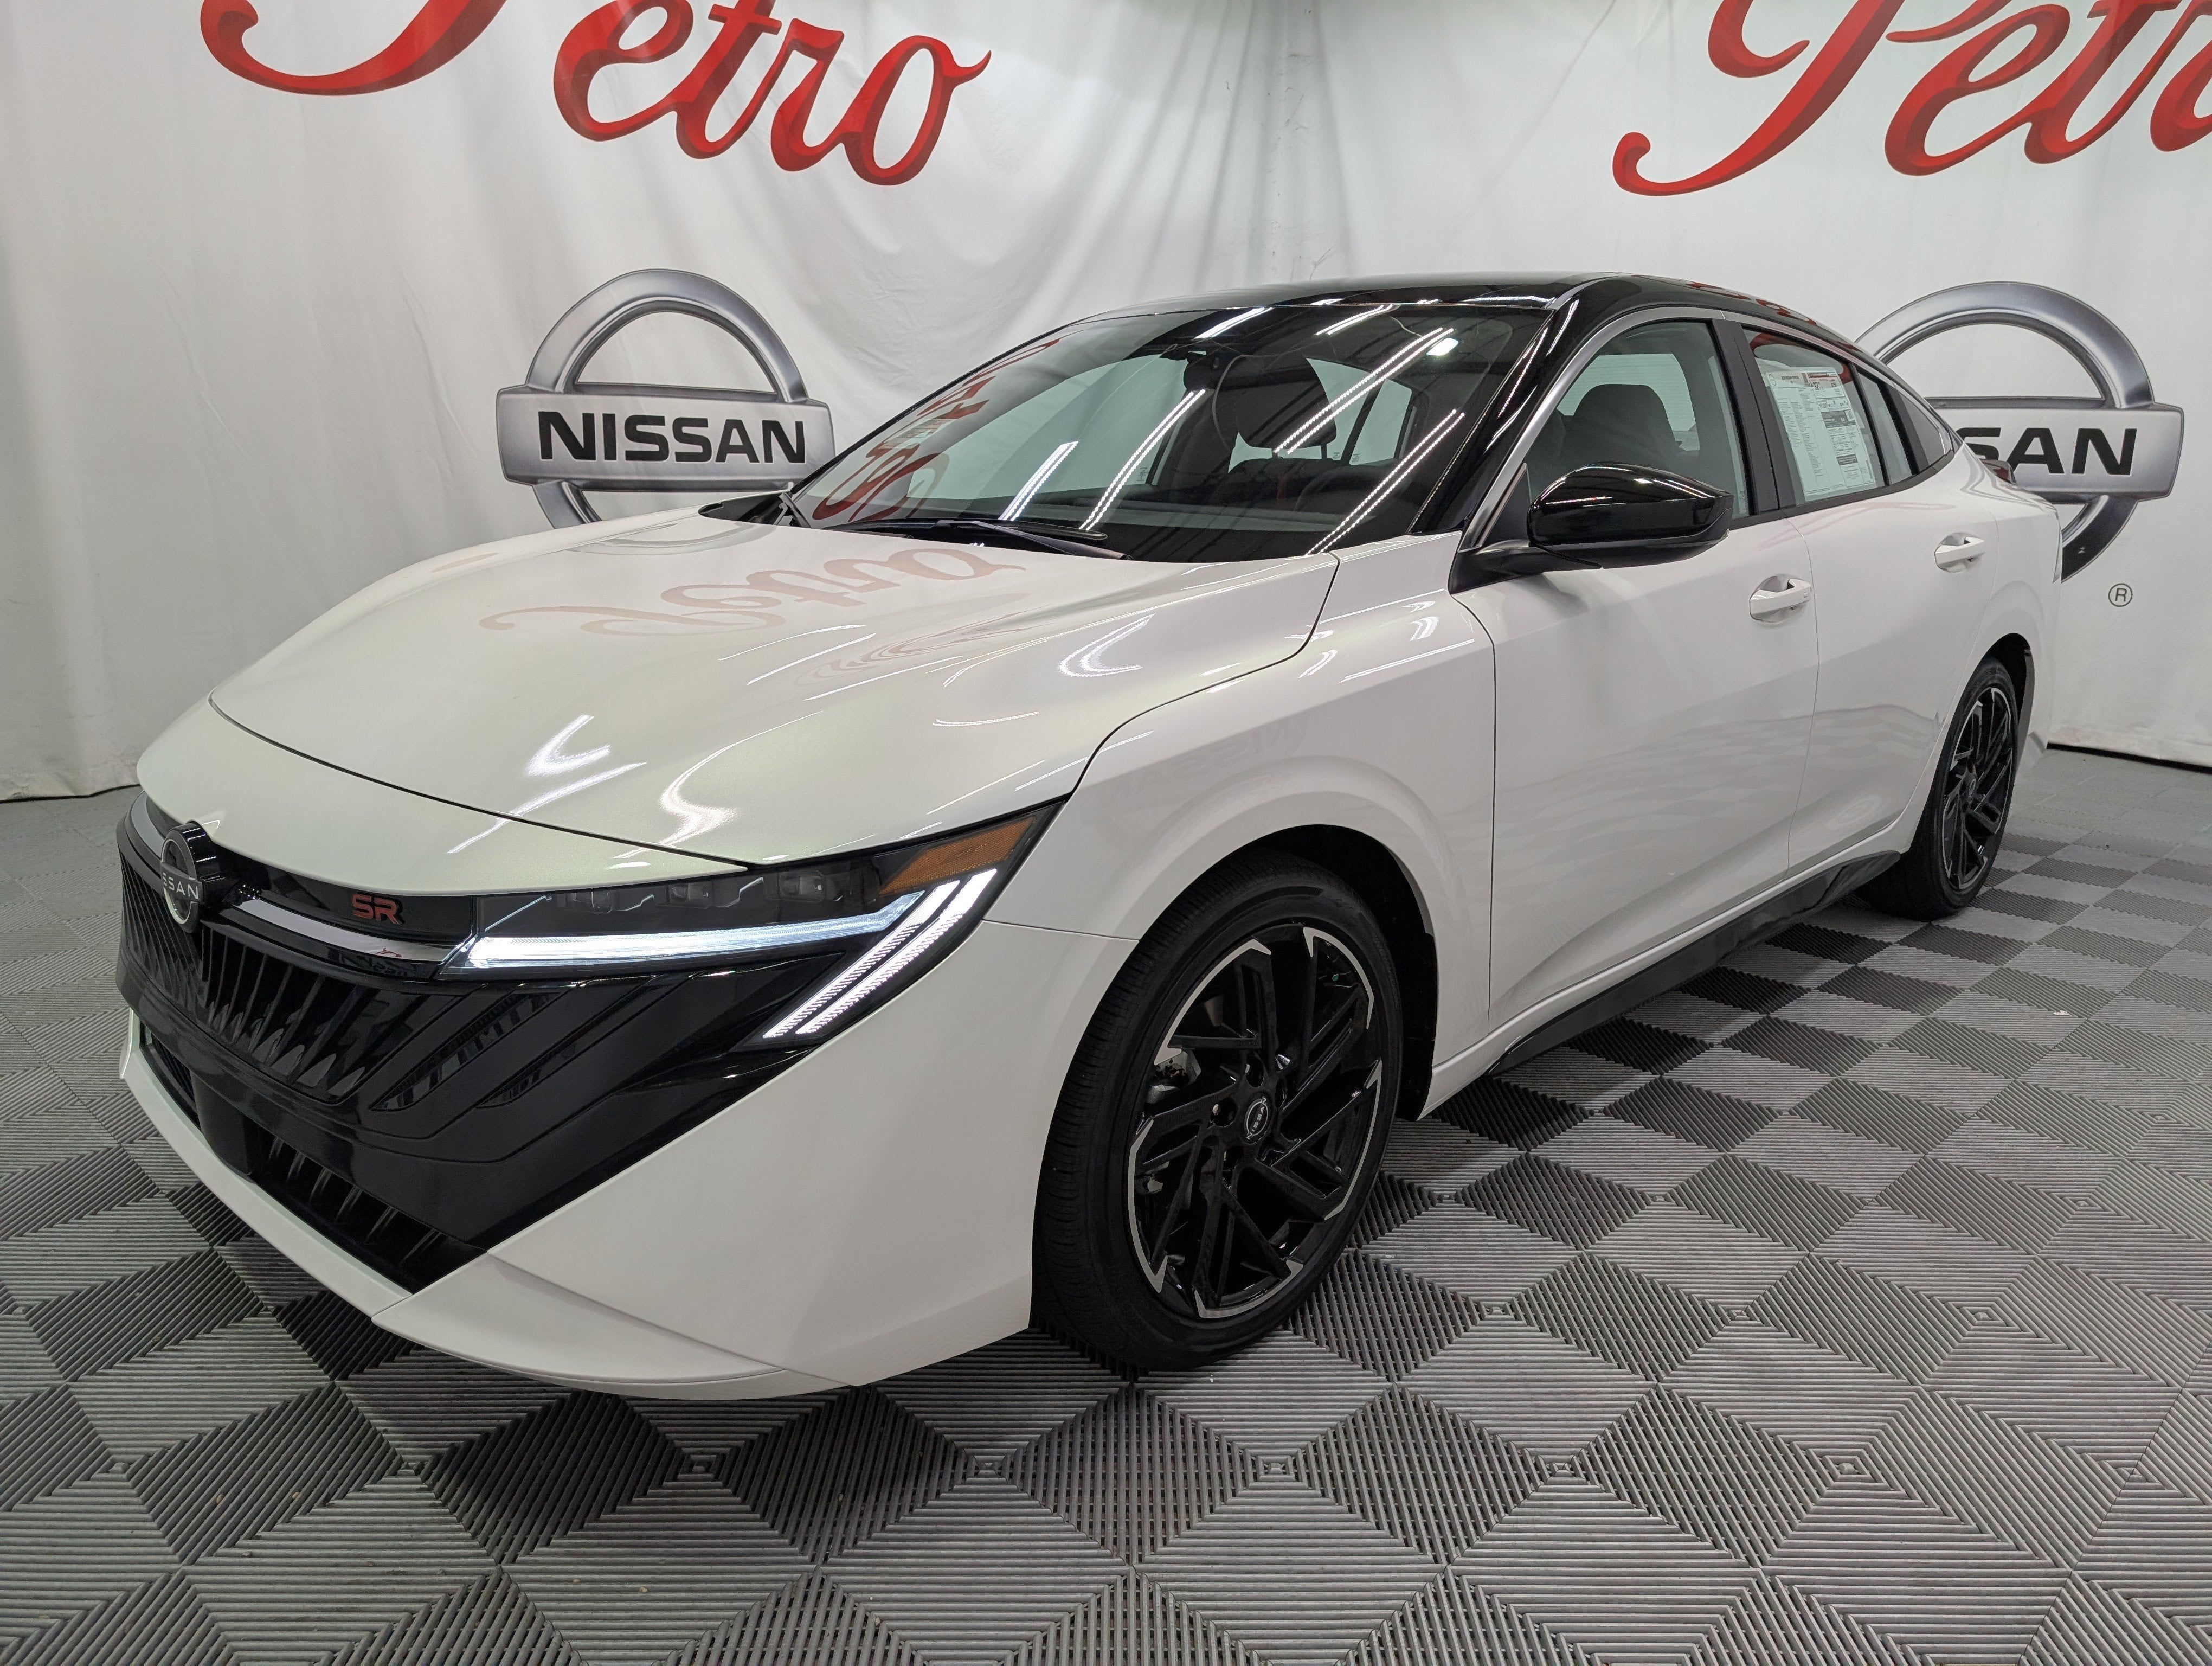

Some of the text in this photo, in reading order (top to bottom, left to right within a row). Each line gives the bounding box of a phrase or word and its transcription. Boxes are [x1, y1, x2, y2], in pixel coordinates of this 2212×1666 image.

[538, 410, 805, 465] NISSAN
[1956, 427, 2137, 476] SAN
[351, 893, 400, 925] SR
[1246, 1096, 1266, 1140] NISSAN
